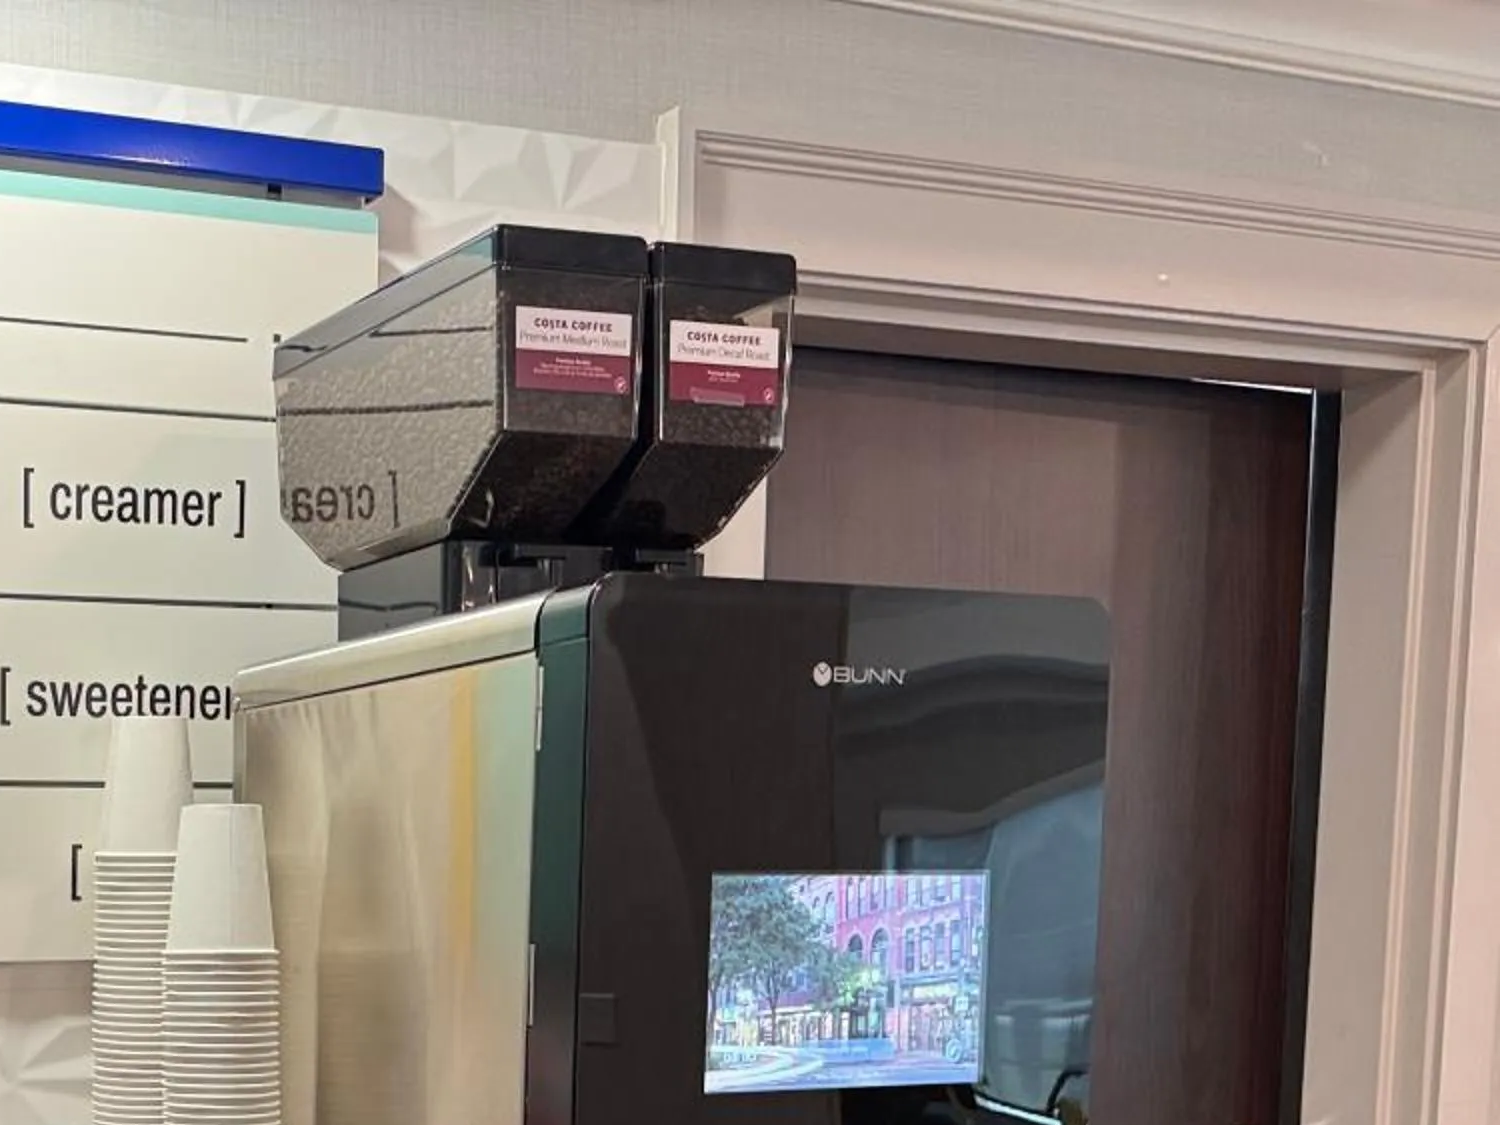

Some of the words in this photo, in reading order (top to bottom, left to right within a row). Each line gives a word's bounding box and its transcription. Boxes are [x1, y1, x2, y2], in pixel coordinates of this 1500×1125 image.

[534, 317, 569, 330] COSTA
[571, 319, 613, 333] COFFEE
[687, 331, 719, 343] COSTA
[721, 333, 761, 346] COFFEE
[49, 481, 223, 527] creamer
[833, 664, 907, 686] BUNN
